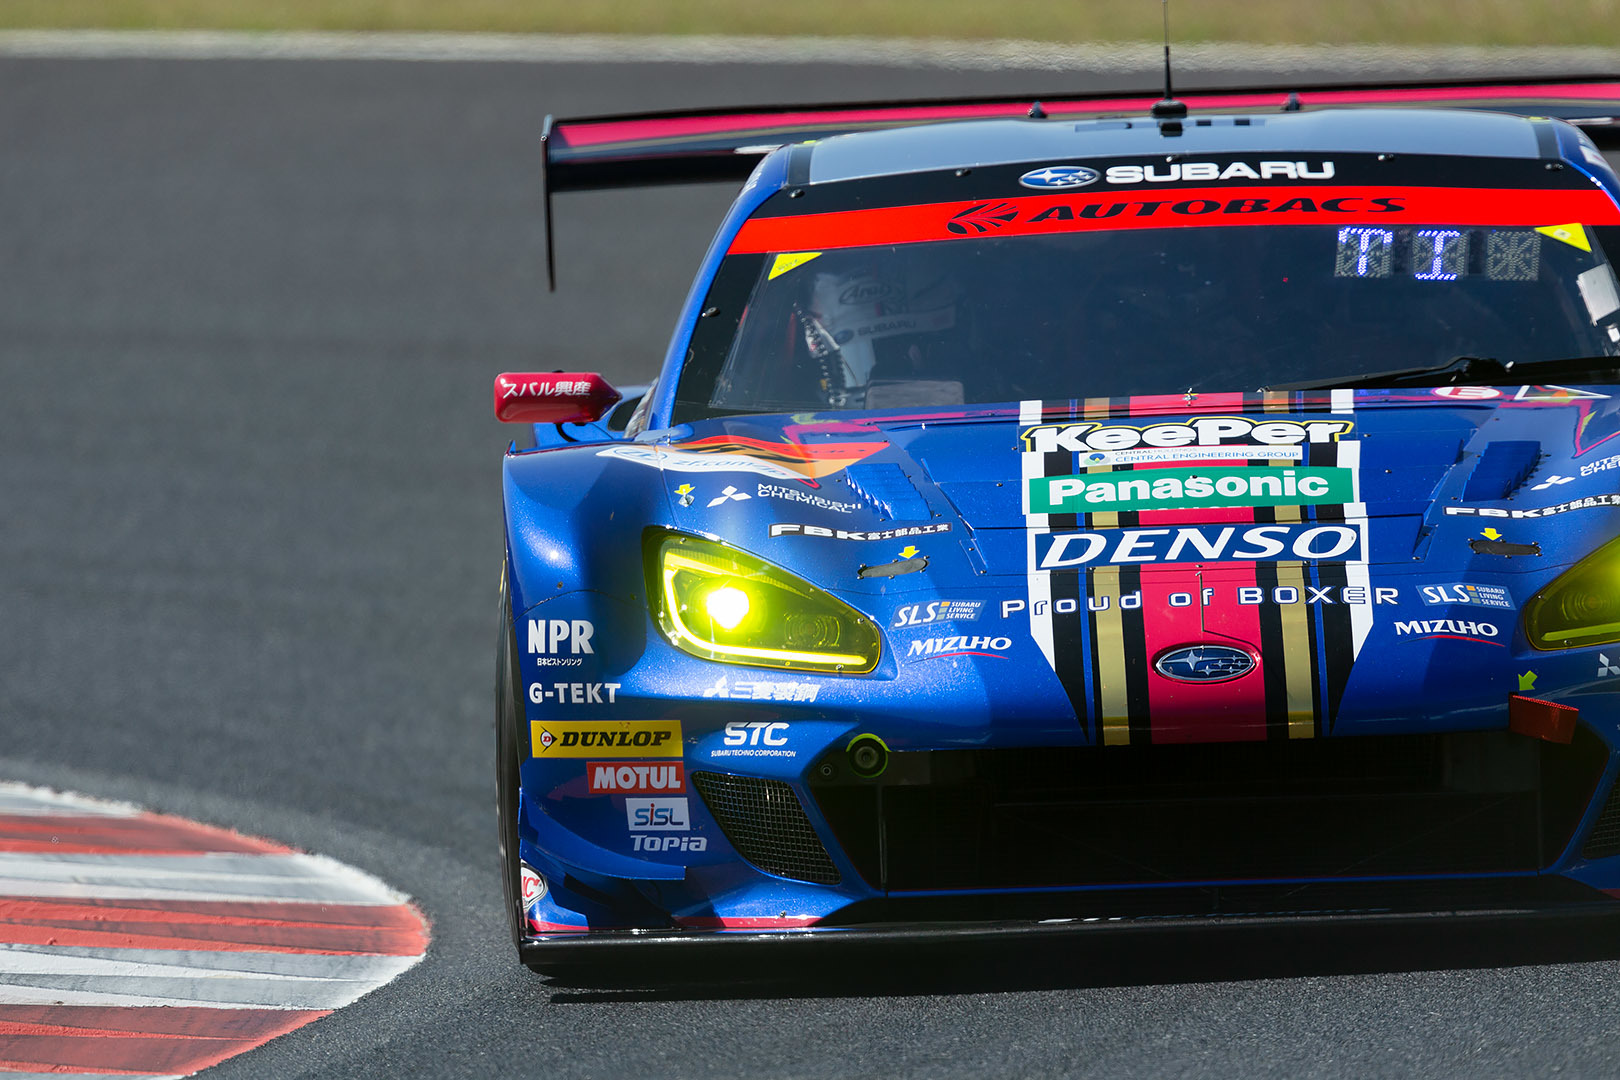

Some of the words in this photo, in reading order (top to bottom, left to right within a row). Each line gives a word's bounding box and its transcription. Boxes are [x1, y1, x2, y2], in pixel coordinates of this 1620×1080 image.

[1106, 160, 1335, 185] SUBARU
[1026, 197, 1407, 223] AUTOBACS
[858, 320, 917, 336] SUBARU
[503, 381, 592, 398] スバル興産
[1030, 417, 1348, 452] KeePer
[1115, 453, 1169, 463] CENTRAL
[1172, 451, 1254, 460] ENGINEERING
[1257, 451, 1299, 459] GROUP
[758, 484, 862, 510] MITSUBISHI
[1050, 470, 1330, 505] Panasonic
[758, 489, 852, 513] CHEMICAL
[1446, 507, 1541, 519] FBK
[771, 524, 866, 541] FBK
[1040, 526, 1358, 569] DENSO
[1001, 591, 1142, 618] Proud
[1169, 588, 1215, 607] of
[1238, 585, 1399, 606] BOXER
[1423, 584, 1470, 603] SLS
[1476, 586, 1505, 595] SUBARU
[894, 602, 939, 626] SLS
[1481, 599, 1511, 607] SERVICE
[528, 619, 595, 654] NPR
[1394, 620, 1499, 637] MIZUHO
[907, 636, 1012, 657] MIZUHO
[529, 682, 621, 704] G-TEKT
[560, 731, 672, 747] DUNLOP
[723, 721, 790, 746] STC
[710, 749, 732, 758] SUBARU
[732, 749, 754, 757] TECHNO
[755, 749, 797, 758] CORPORATION
[593, 766, 682, 789] MOTUL
